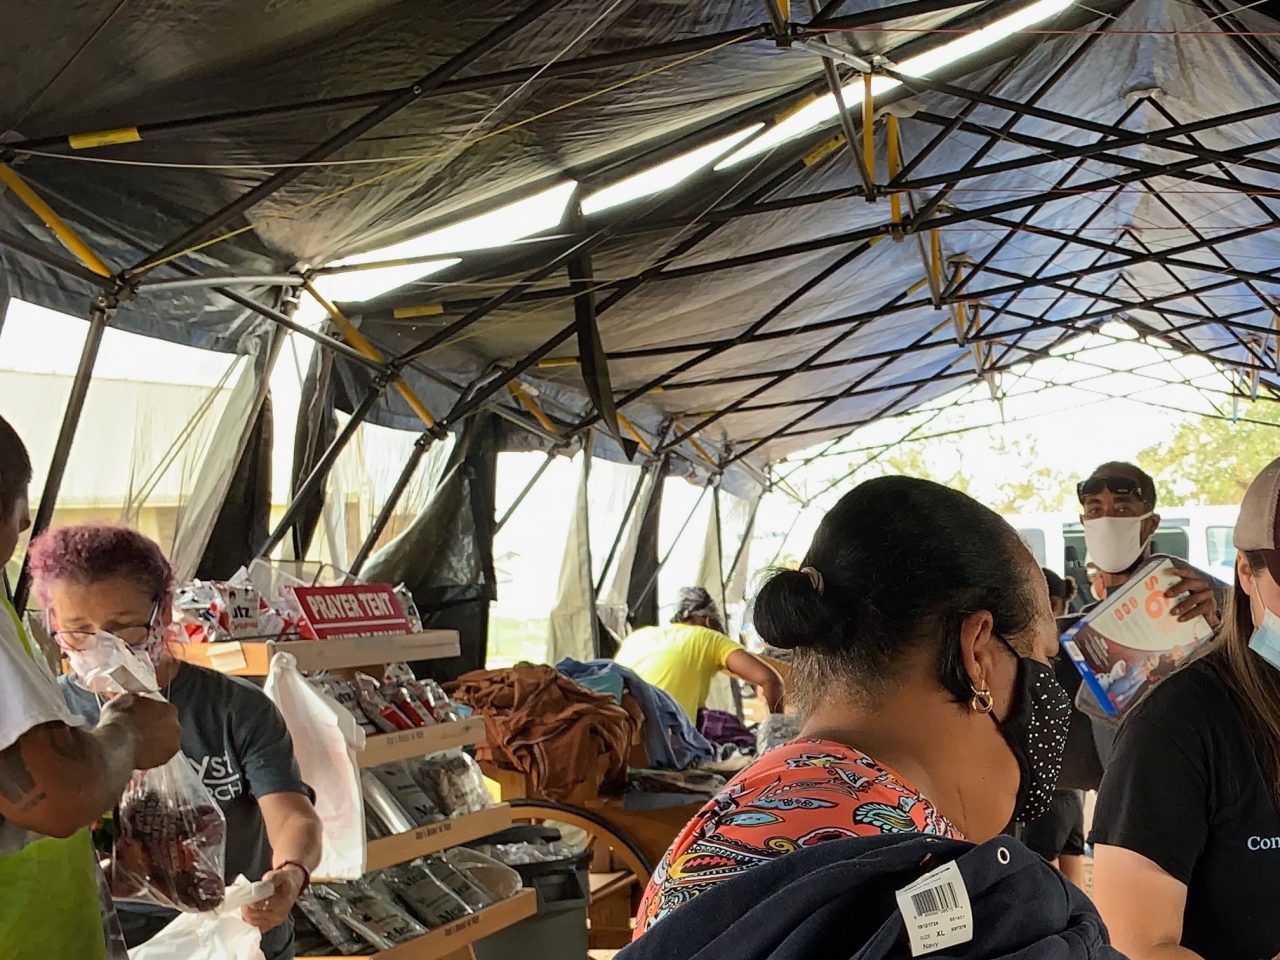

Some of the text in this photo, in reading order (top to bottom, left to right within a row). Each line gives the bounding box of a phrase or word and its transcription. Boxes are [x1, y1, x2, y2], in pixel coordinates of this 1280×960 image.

[306, 592, 395, 620] PRAYER TENT
[936, 930, 946, 938] XL
